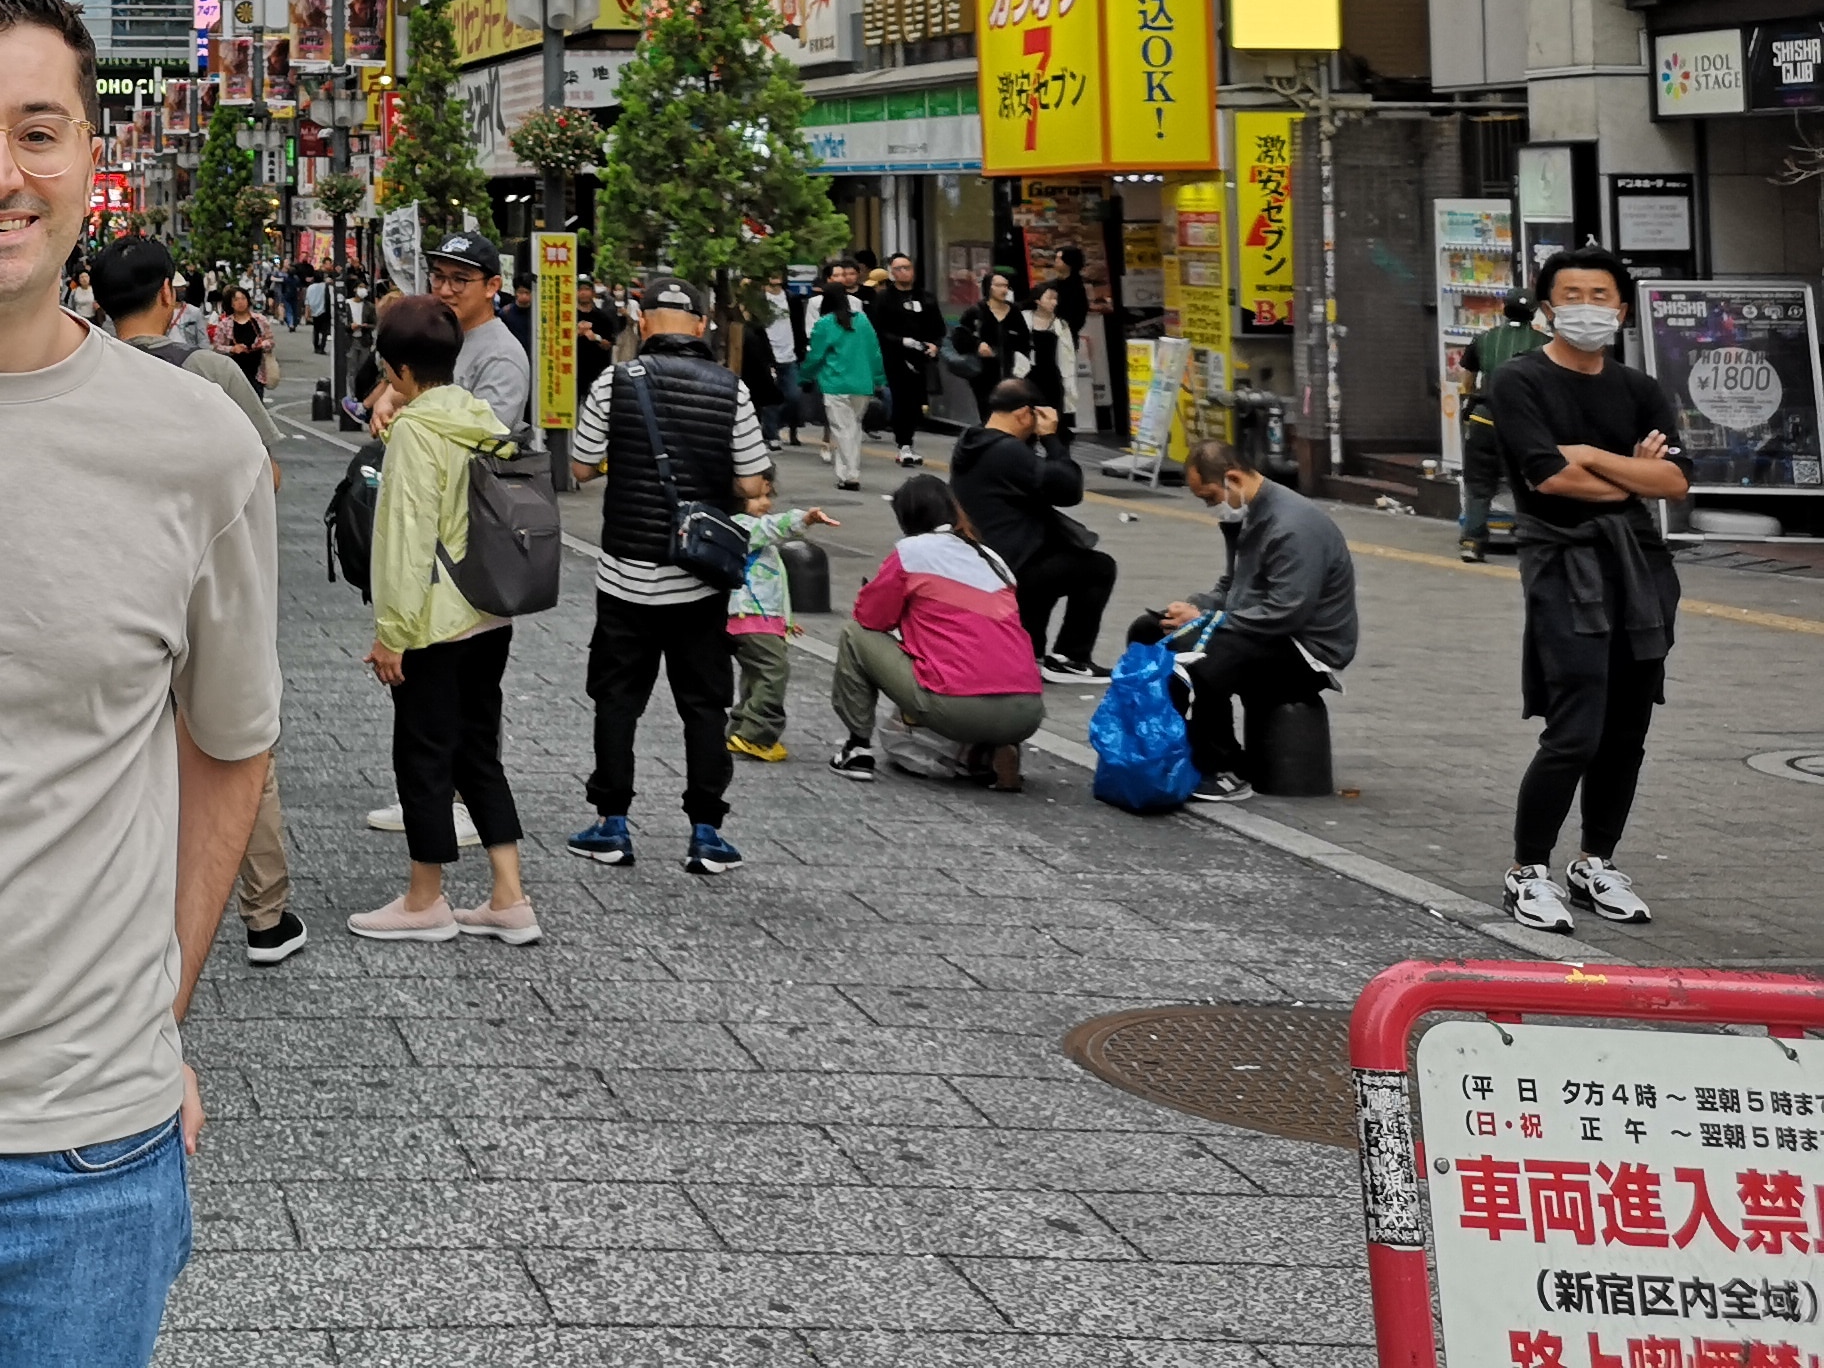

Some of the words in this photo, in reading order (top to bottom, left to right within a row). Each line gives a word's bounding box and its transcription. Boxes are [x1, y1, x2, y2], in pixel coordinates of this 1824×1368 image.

[197, 5, 218, 16] 747
[1694, 53, 1733, 73] IDOL
[1772, 38, 1822, 67] SHISHA
[1694, 71, 1742, 92] STAGE
[1781, 59, 1815, 85] CLUB
[996, 67, 1088, 120] 激安セブン
[1254, 134, 1288, 278] 激安セブン
[1653, 301, 1708, 319] SHISHA
[1701, 350, 1767, 365] HOOKAH
[1697, 366, 1772, 391] ¥1800
[1536, 1268, 1818, 1324] (新宿区内全域)
